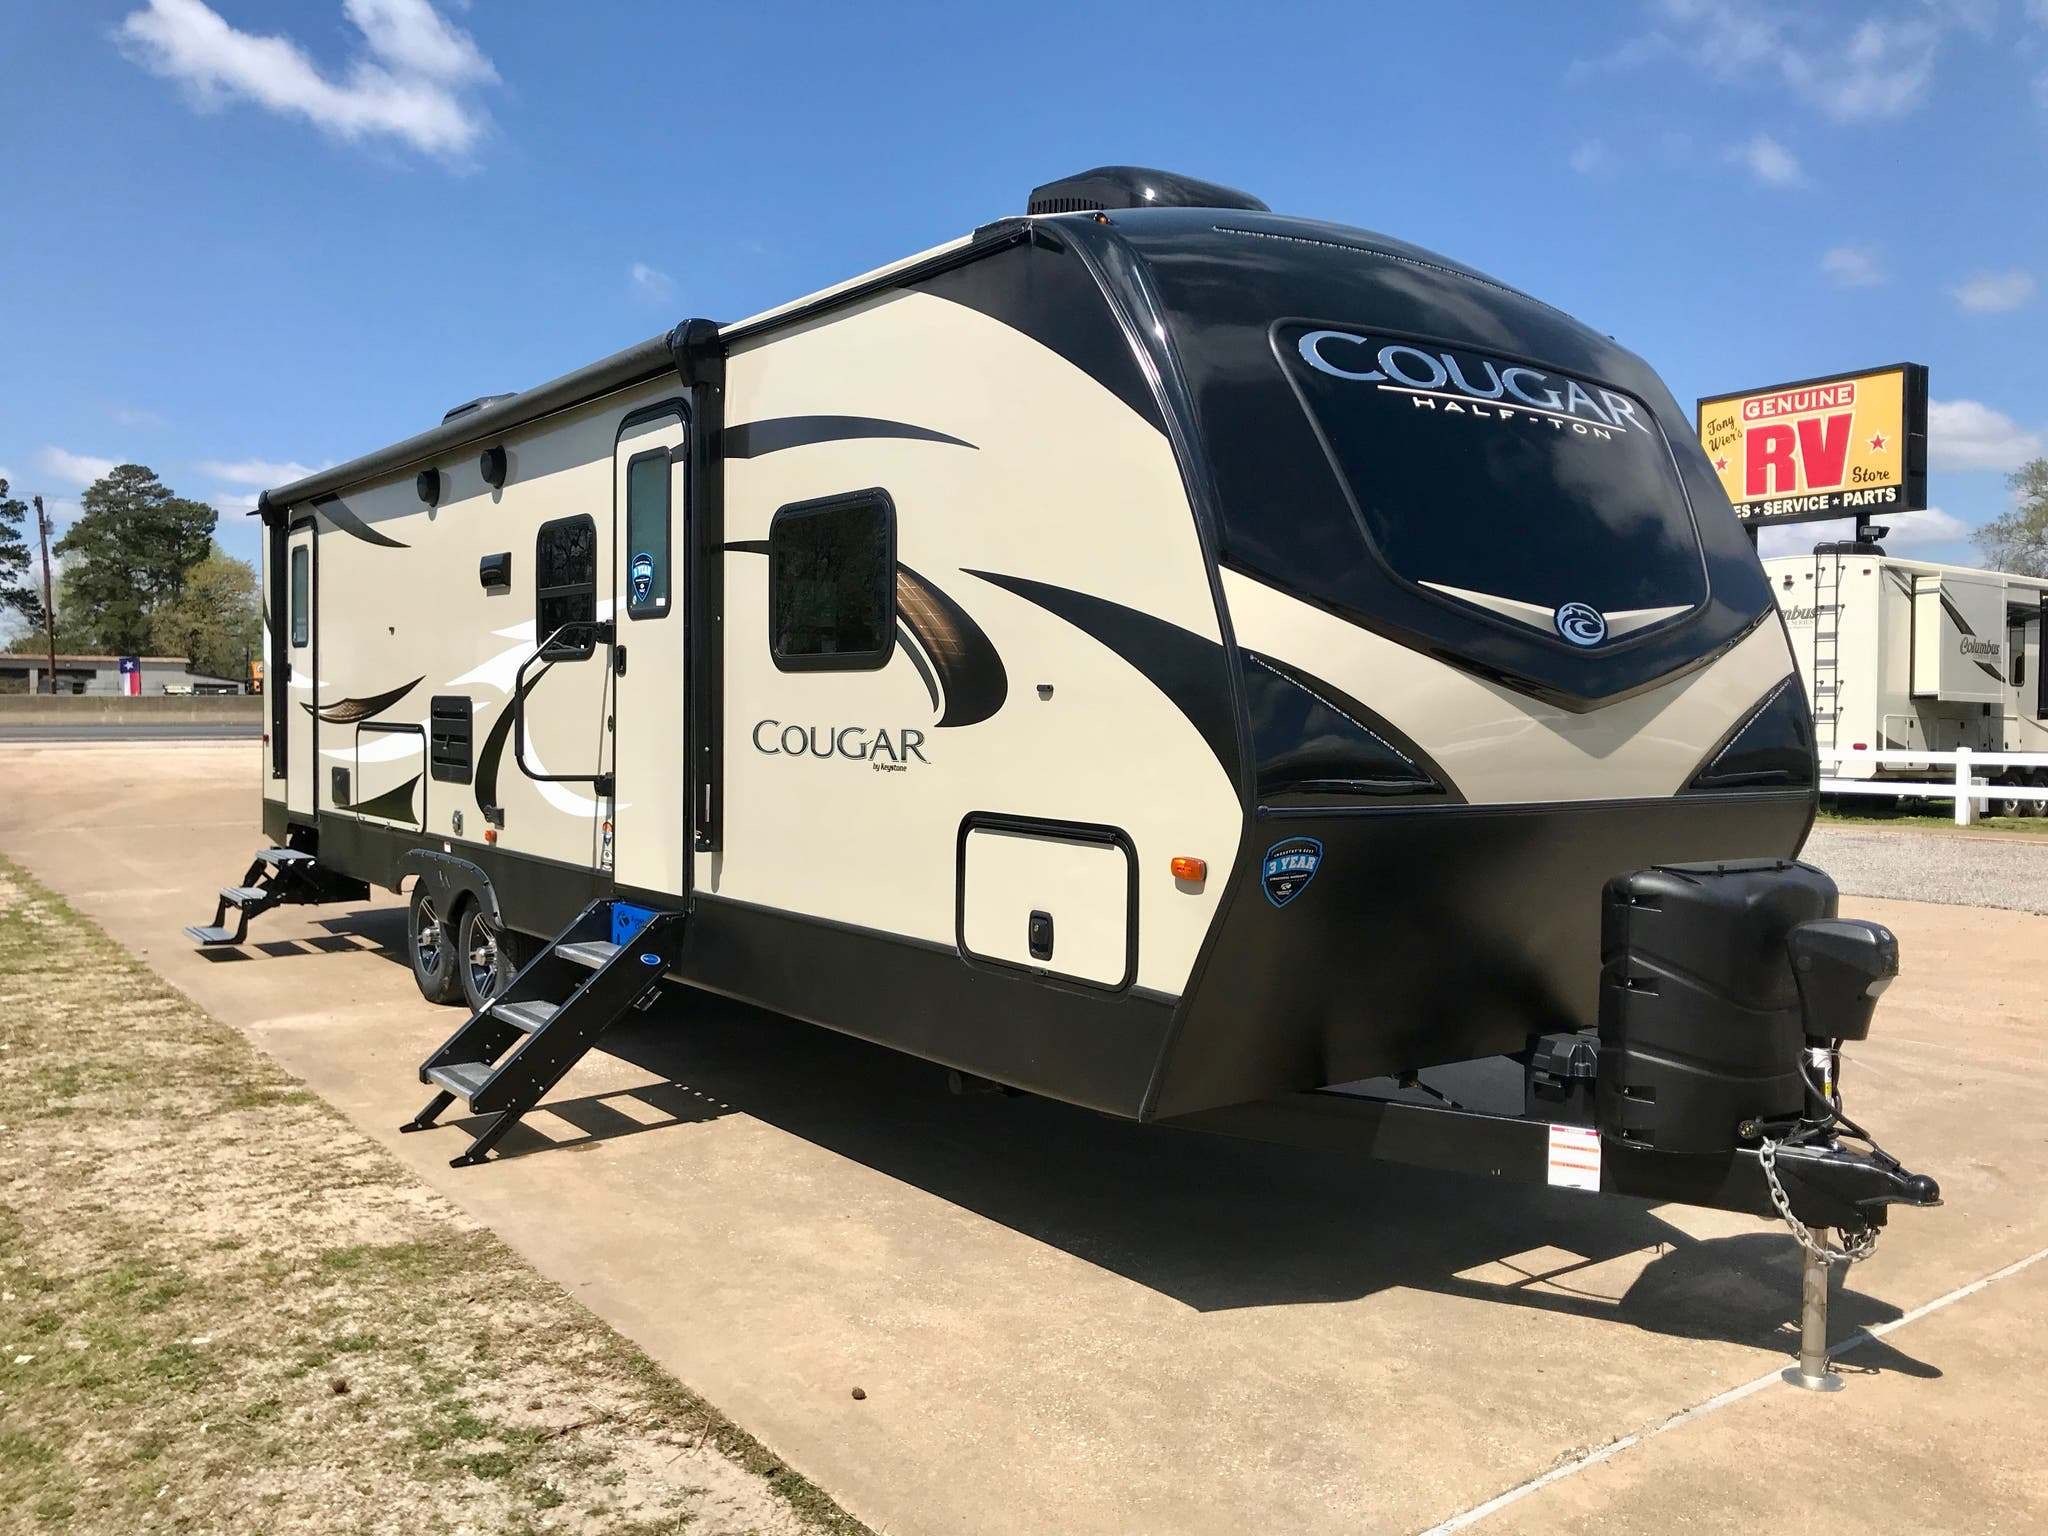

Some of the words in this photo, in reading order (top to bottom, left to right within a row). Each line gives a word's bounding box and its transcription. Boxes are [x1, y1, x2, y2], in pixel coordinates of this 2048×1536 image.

[1298, 330, 1651, 434] COUGAR
[1745, 386, 1852, 418] GENUINE
[1706, 415, 1735, 436] Tony
[1708, 427, 1743, 452] Wier's
[1745, 412, 1853, 497] RV
[1852, 466, 1890, 483] Store
[1763, 495, 1829, 516] SERVICE
[1843, 487, 1896, 507] PARTS
[1960, 636, 2000, 655] Columbus
[752, 719, 932, 765] COUGAR
[1268, 861, 1277, 875] 3
[1280, 855, 1317, 870] YEAR
